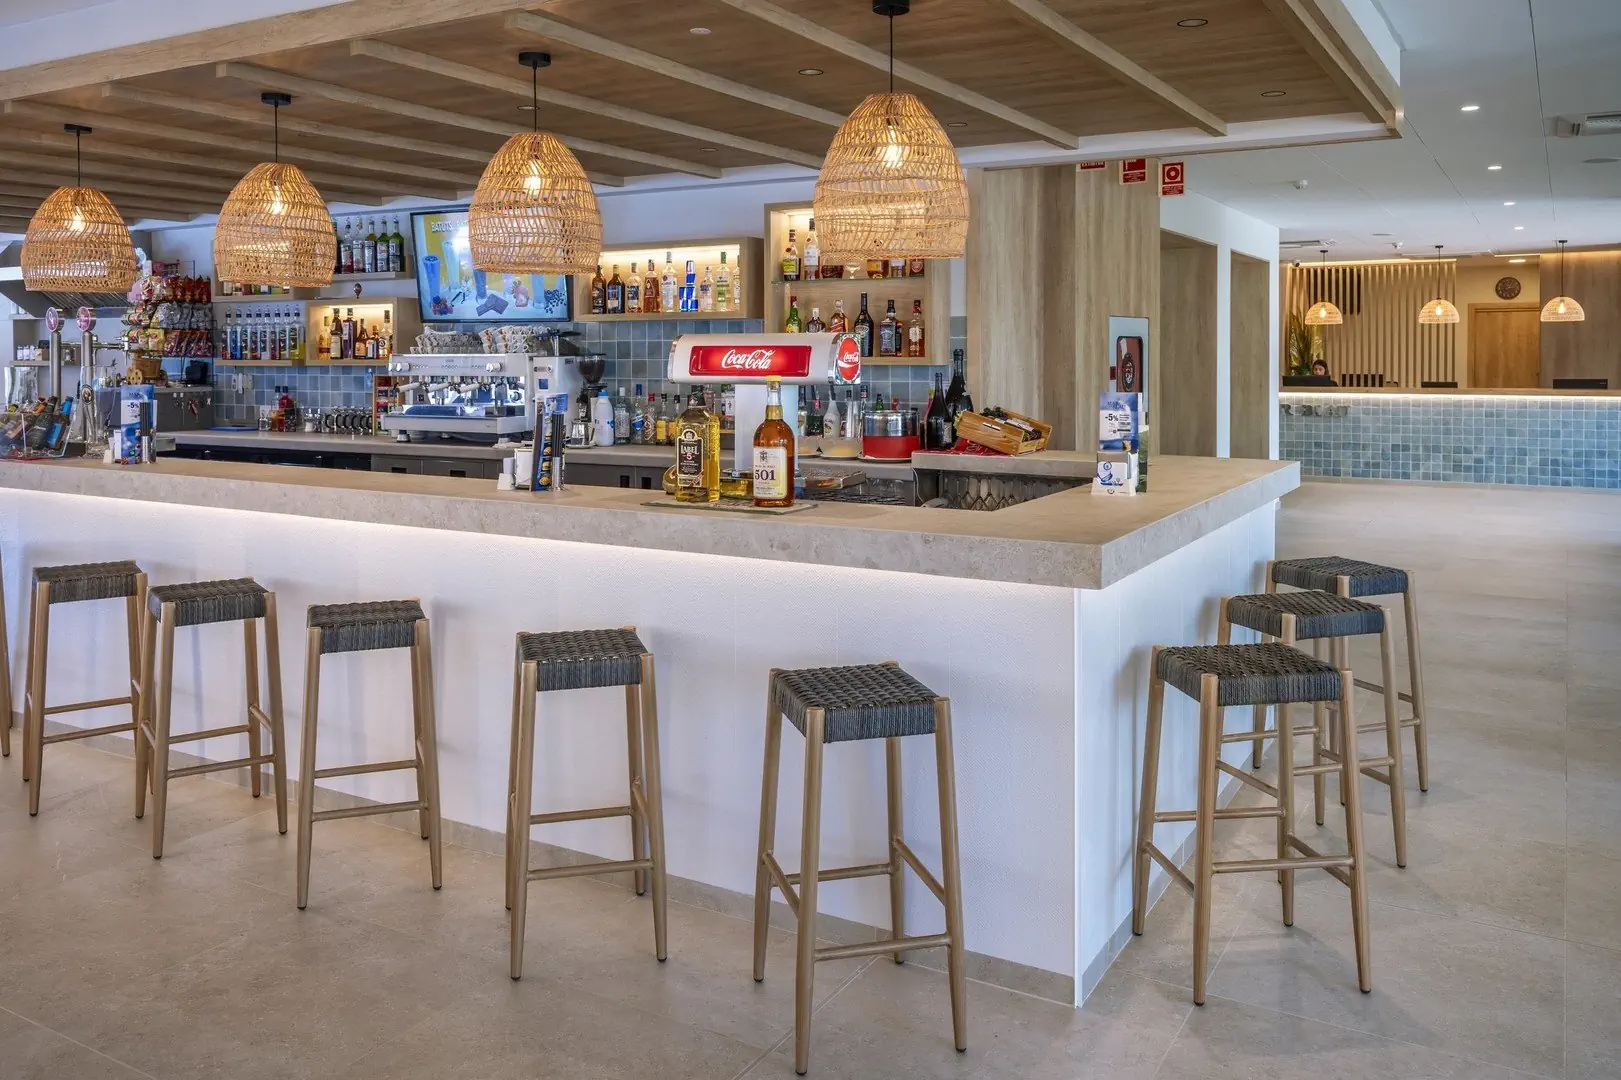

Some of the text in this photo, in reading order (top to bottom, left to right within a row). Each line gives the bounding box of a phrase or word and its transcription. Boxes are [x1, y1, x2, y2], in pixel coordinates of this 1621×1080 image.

[721, 349, 776, 370] Coca-Cola
[1105, 413, 1119, 422] -5%
[680, 445, 700, 455] LABEL
[755, 469, 776, 481] 501
